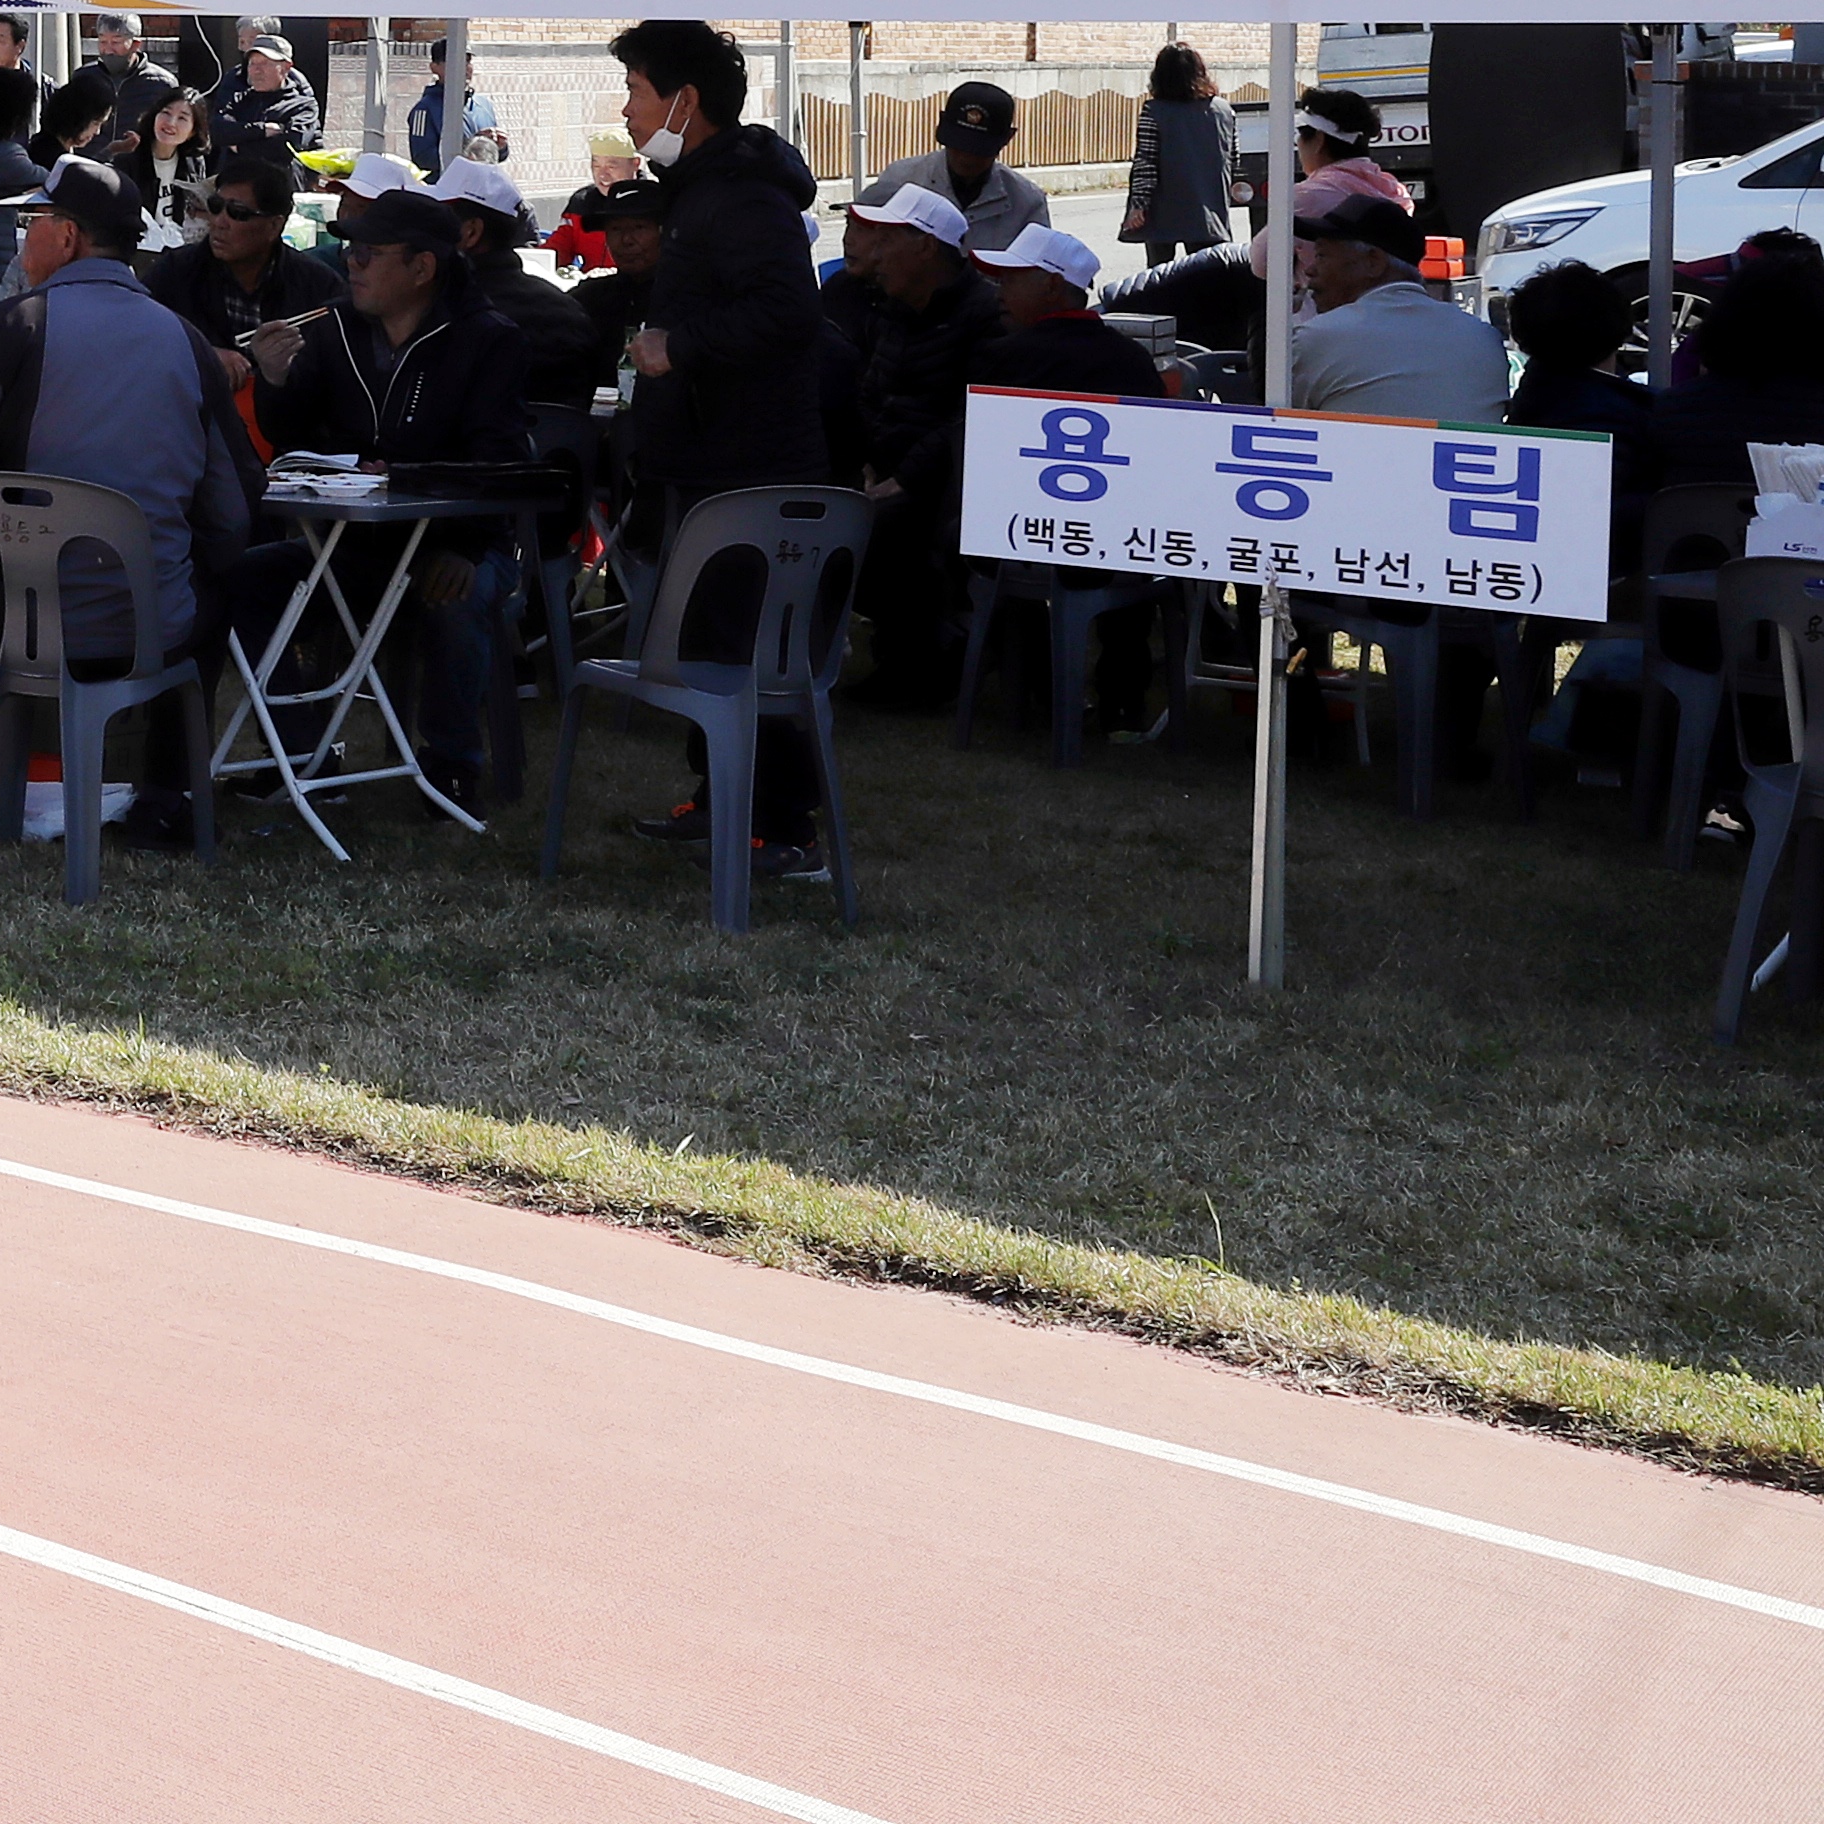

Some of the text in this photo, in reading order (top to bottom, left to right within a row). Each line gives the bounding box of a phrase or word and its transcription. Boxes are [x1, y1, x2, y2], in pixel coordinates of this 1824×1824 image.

[1007, 513, 1107, 561] (백동,
[1122, 525, 1209, 571] 신동,
[1335, 546, 1426, 593] 남선,
[1445, 557, 1544, 604] 남동)
